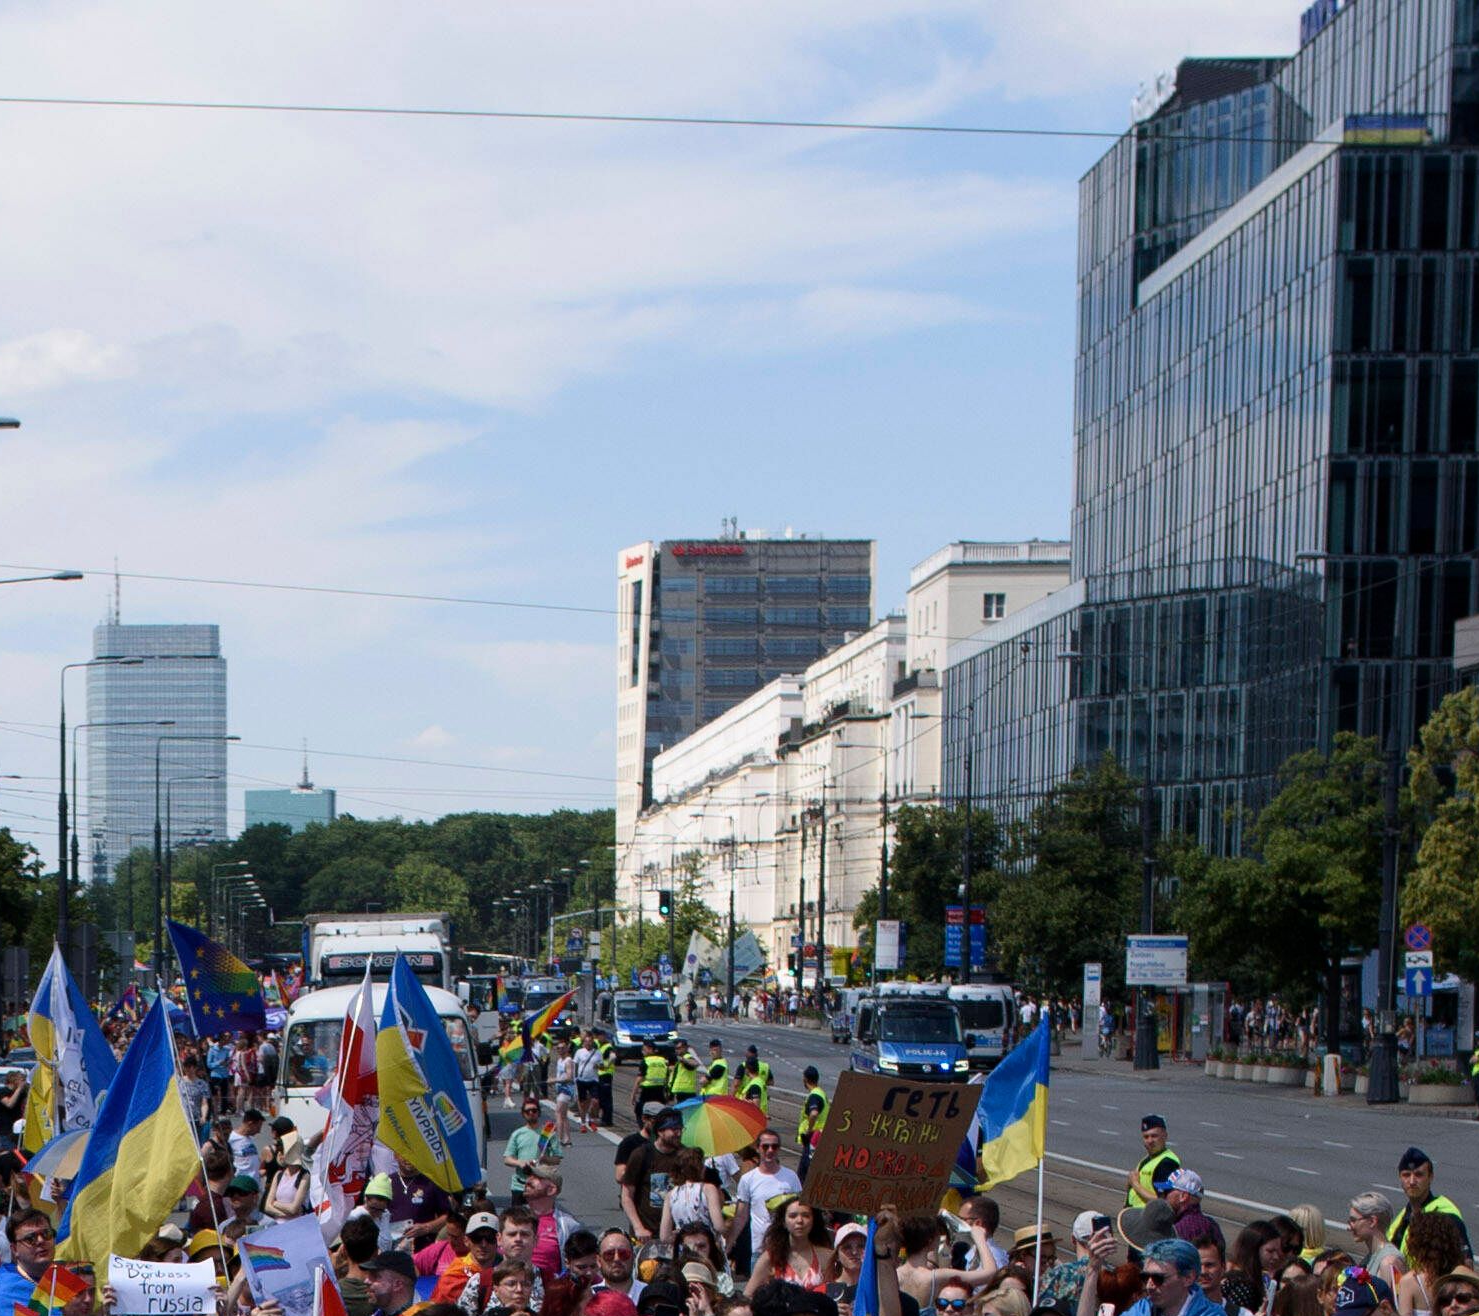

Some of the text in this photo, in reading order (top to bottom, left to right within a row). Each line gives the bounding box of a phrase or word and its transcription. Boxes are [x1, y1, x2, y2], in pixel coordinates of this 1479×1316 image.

[408, 1095, 446, 1162] YIVPRIDE
[113, 1257, 153, 1269] Save
[128, 1268, 191, 1280] Donbass
[138, 1280, 175, 1295] from
[147, 1295, 204, 1314] russia
